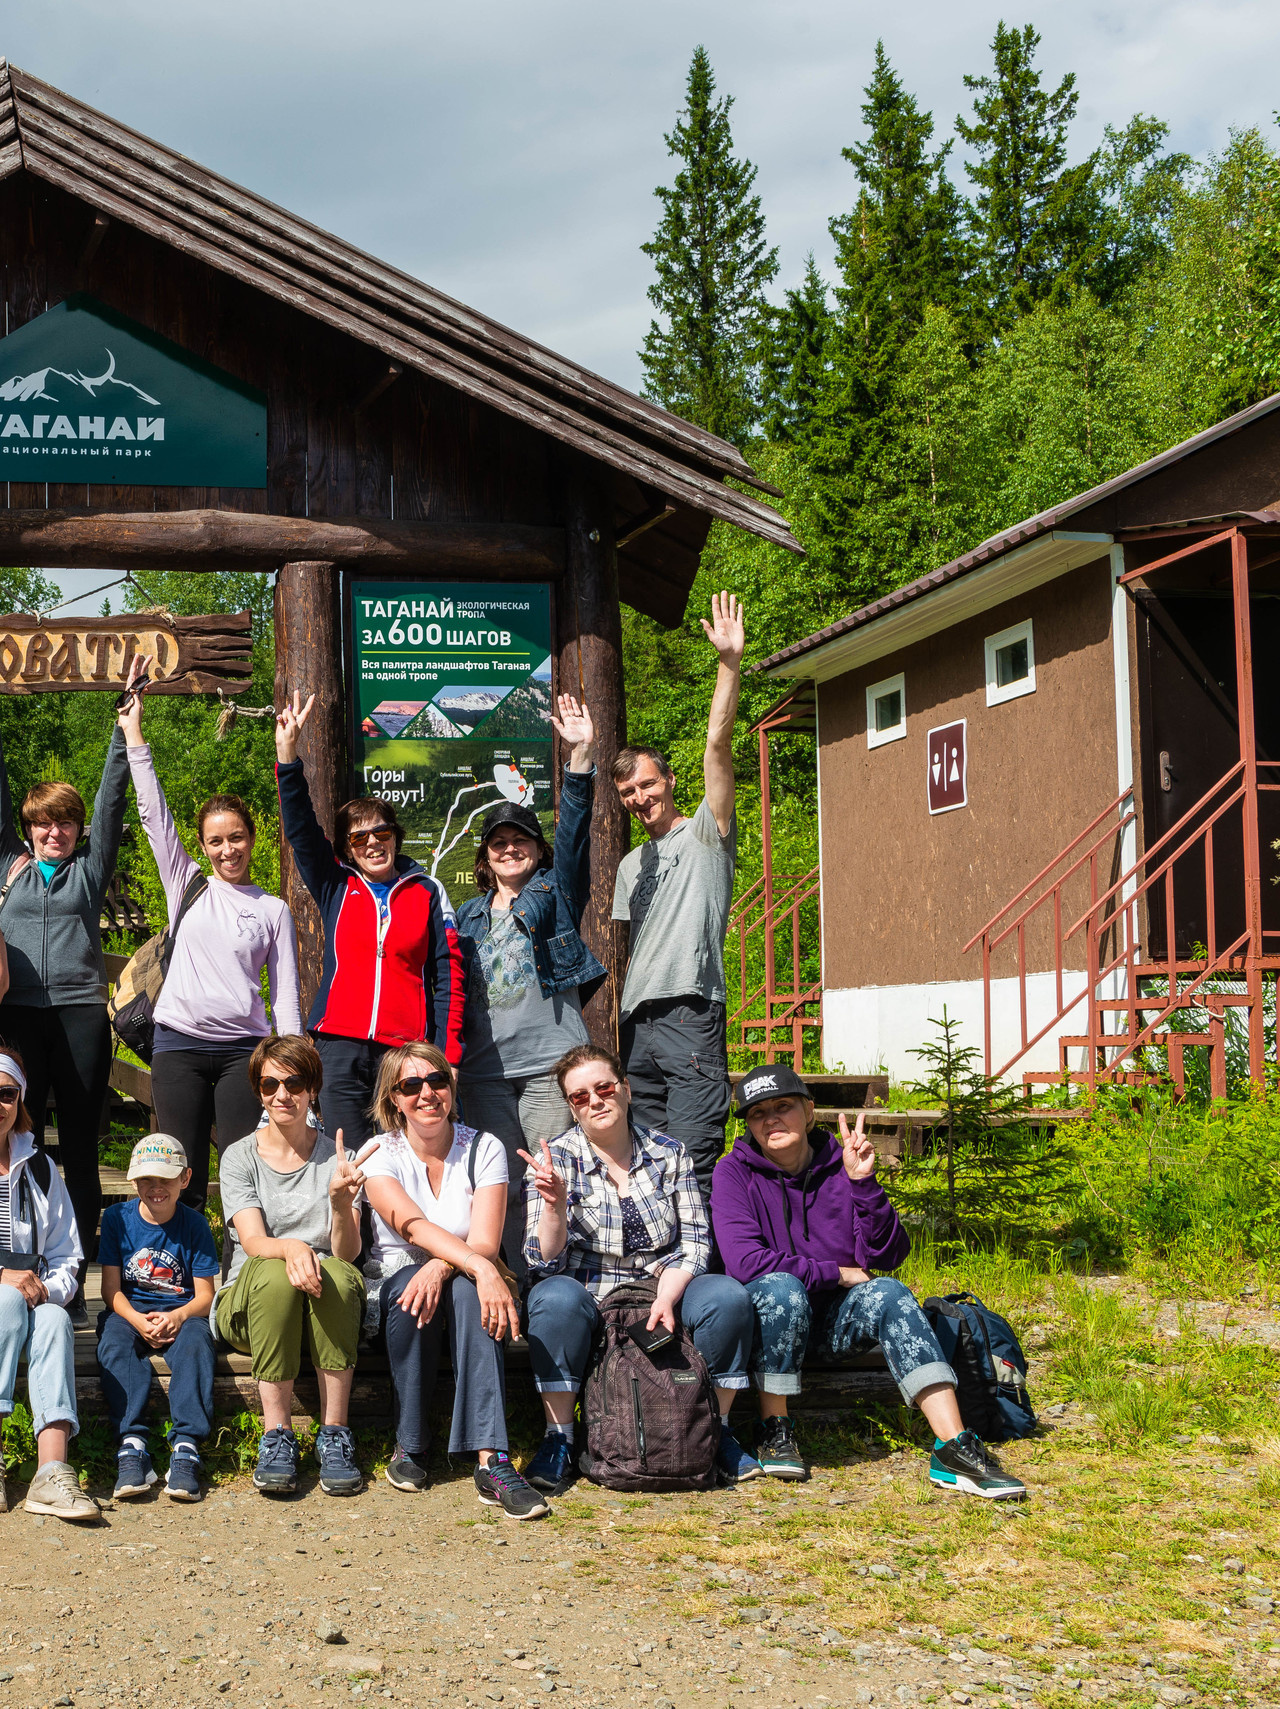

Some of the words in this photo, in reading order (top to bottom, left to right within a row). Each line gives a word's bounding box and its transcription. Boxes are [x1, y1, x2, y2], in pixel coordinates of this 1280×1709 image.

[115, 448, 152, 458] парк
[361, 597, 454, 618] ТАГАНАЙ
[457, 602, 530, 610] ЭКОЛОГИЧЕСКАЯ
[457, 610, 485, 619] ТРОПА
[361, 629, 386, 645] ЗА
[388, 619, 442, 645] 600
[446, 631, 511, 646] ШАГОВ
[361, 660, 379, 669] Вся
[382, 661, 423, 670] палитра
[425, 661, 489, 671] ландшафтов
[491, 661, 530, 671] Таганая
[376, 671, 406, 681] одной
[409, 672, 438, 680] тропе
[363, 766, 405, 790] Горы
[372, 783, 425, 808] зовут!
[454, 871, 478, 885] ЛЕ
[743, 1074, 777, 1096] PEAK
[136, 1145, 173, 1155] WINNER
